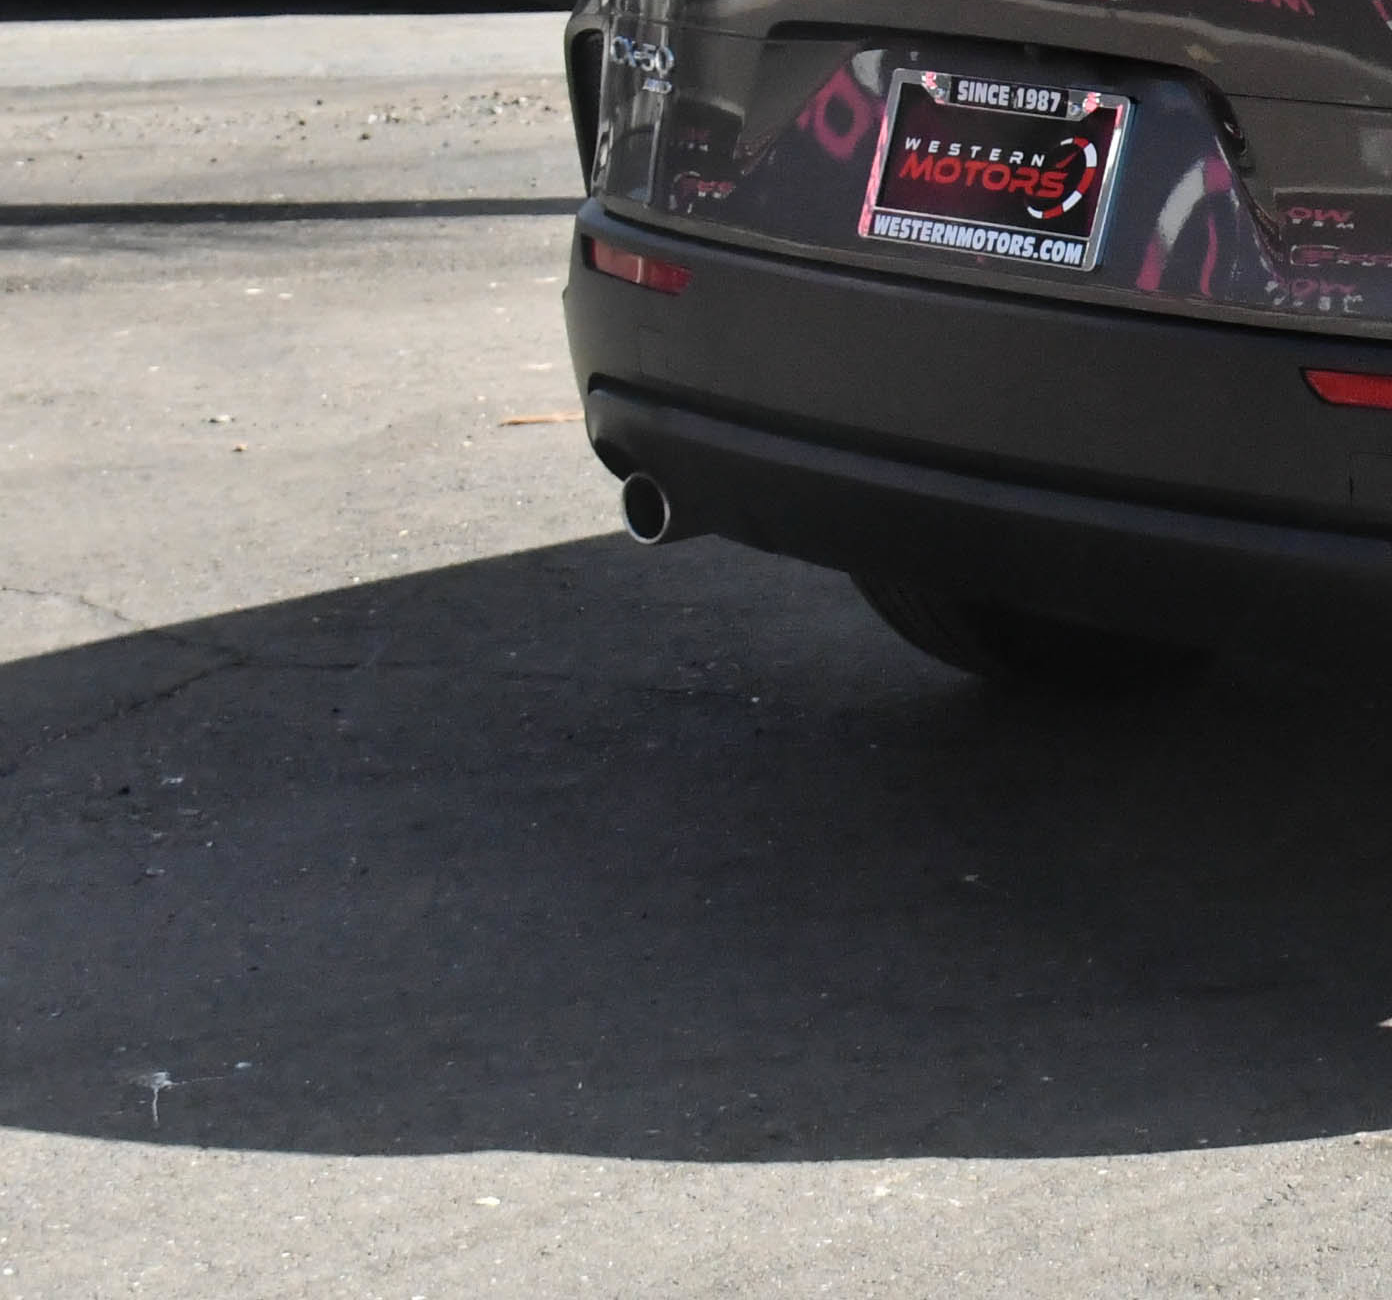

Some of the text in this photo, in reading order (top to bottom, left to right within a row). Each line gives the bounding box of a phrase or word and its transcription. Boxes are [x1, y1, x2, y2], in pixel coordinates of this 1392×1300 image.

[957, 80, 1062, 113] SINCE 1987
[904, 136, 1047, 168] WESTERN
[898, 152, 1070, 199] MOTORS
[873, 213, 1084, 266] WESTERNMOTORS.COM
